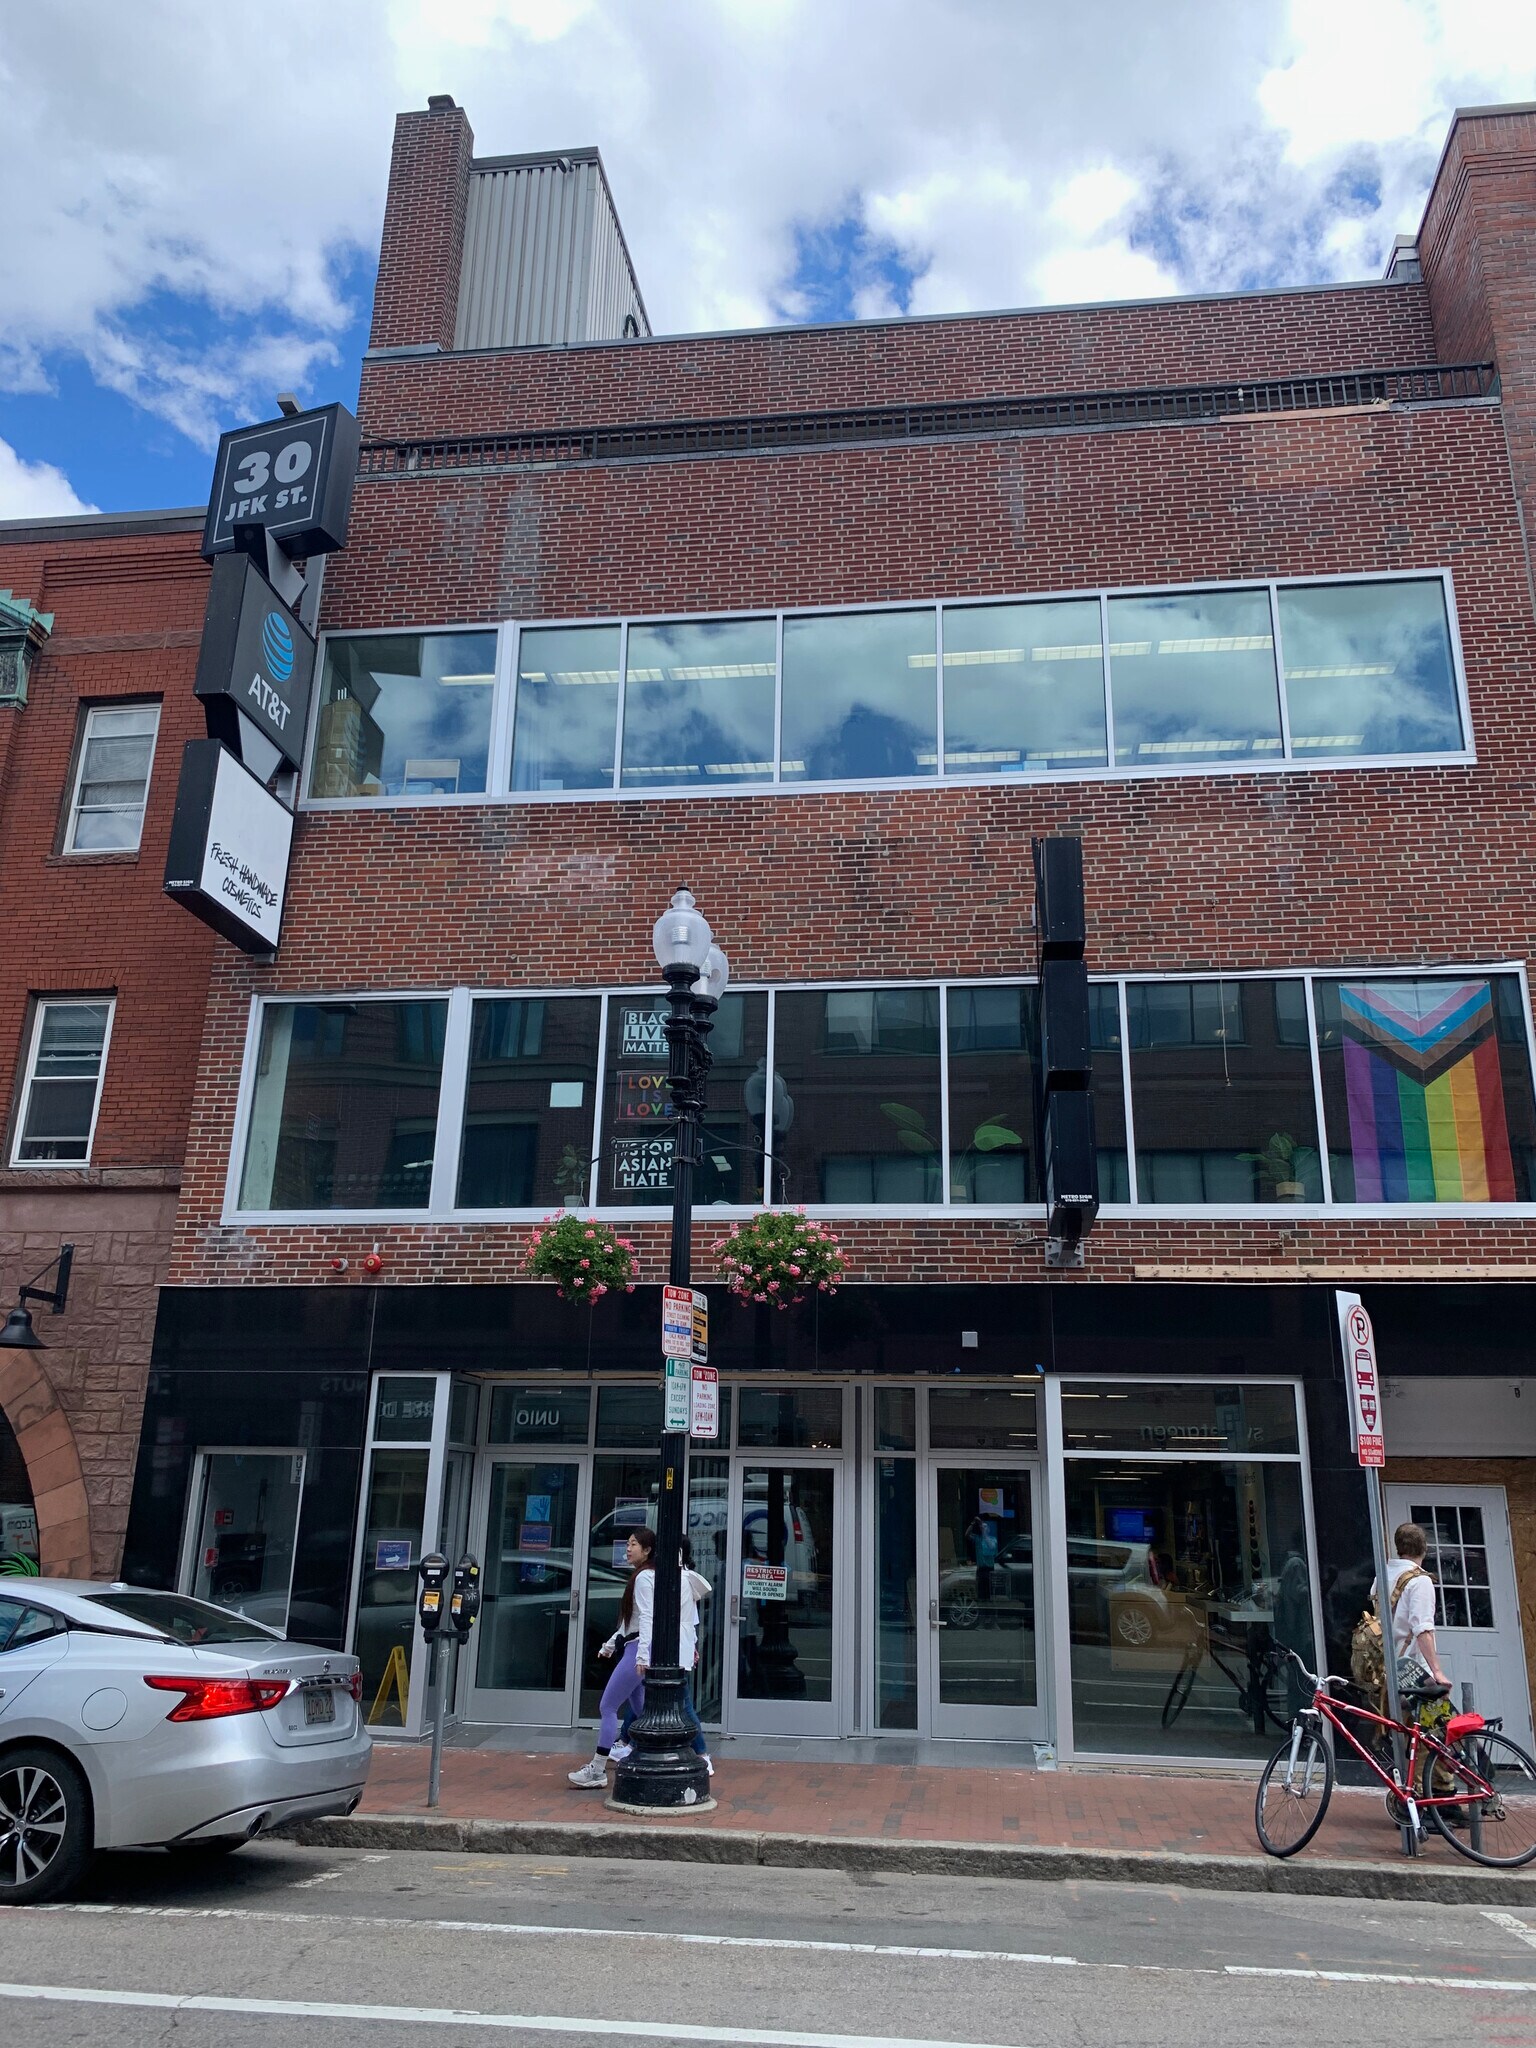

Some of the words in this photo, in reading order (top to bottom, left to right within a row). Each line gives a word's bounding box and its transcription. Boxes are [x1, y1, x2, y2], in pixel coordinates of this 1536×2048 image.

[232, 440, 313, 495] 30
[224, 494, 268, 522] JFK
[274, 489, 308, 511] ST.
[248, 672, 291, 732] AT&T
[210, 842, 239, 875] FRESH
[239, 864, 278, 907] HANDMADE
[222, 876, 262, 919] COSMETICS
[628, 1012, 670, 1025] BLAC
[627, 1025, 667, 1040] LIVE
[625, 1041, 670, 1053] MATTE
[641, 1090, 662, 1103] IS
[627, 1103, 673, 1116] LOVE
[618, 1157, 672, 1171] ASIAN
[623, 1172, 668, 1187] HATE
[667, 1288, 677, 1298] TOW
[677, 1290, 690, 1301] ZONE
[665, 1301, 672, 1310] NO
[673, 1302, 691, 1313] PARKING
[693, 1369, 703, 1379] TOW
[704, 1371, 716, 1381] ZONE
[670, 1394, 687, 1403] EXCEPT
[696, 1392, 713, 1401] PARKING
[668, 1406, 688, 1415] SUNDAYS
[1359, 1435, 1372, 1446] $100
[1372, 1436, 1383, 1446] FINE
[746, 1567, 785, 1576] RESTRICTED
